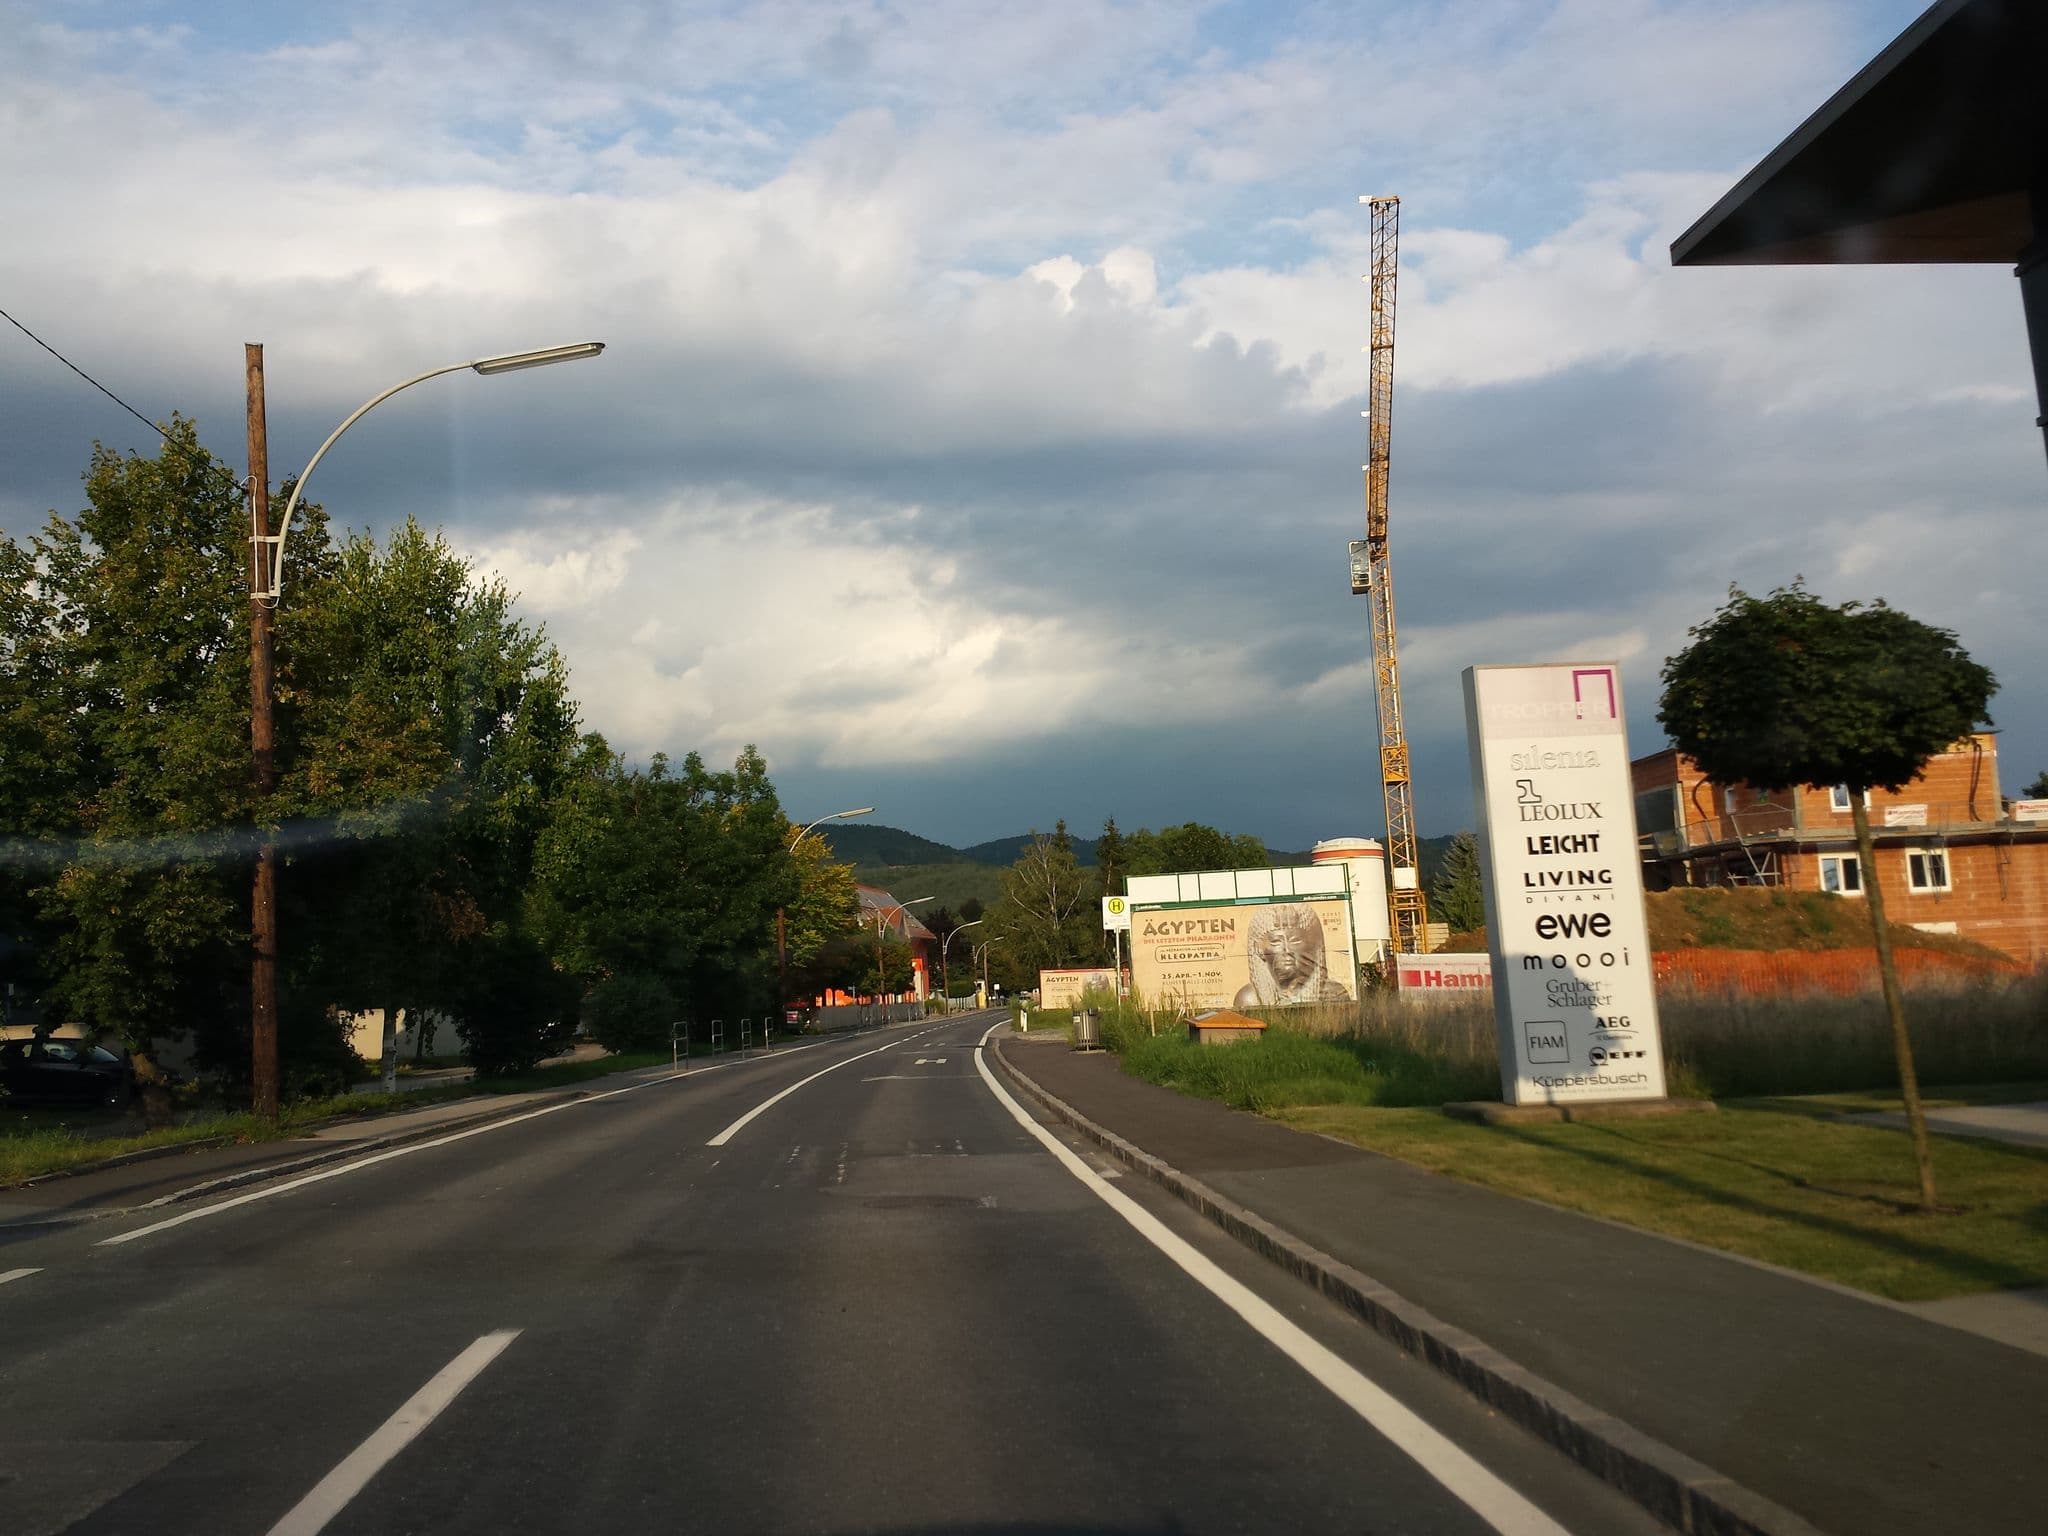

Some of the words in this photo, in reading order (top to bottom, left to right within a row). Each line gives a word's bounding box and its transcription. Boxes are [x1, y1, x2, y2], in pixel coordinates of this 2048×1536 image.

[1519, 802, 1604, 822] LEOLUX
[1526, 833, 1600, 855] LEICHT
[1523, 869, 1613, 887] LIVING
[1112, 901, 1121, 911] H
[1526, 893, 1615, 904] DIVANI
[1142, 918, 1235, 936] ÄGYPTEN
[1535, 912, 1612, 940] ewe
[1160, 951, 1220, 960] KLEOPATRA
[1523, 947, 1629, 970] moooi
[1547, 993, 1613, 1011] Schlager
[1595, 1016, 1631, 1029] AEG
[1530, 1036, 1564, 1049] FIAM
[1532, 1072, 1648, 1088] Küppersbusch
